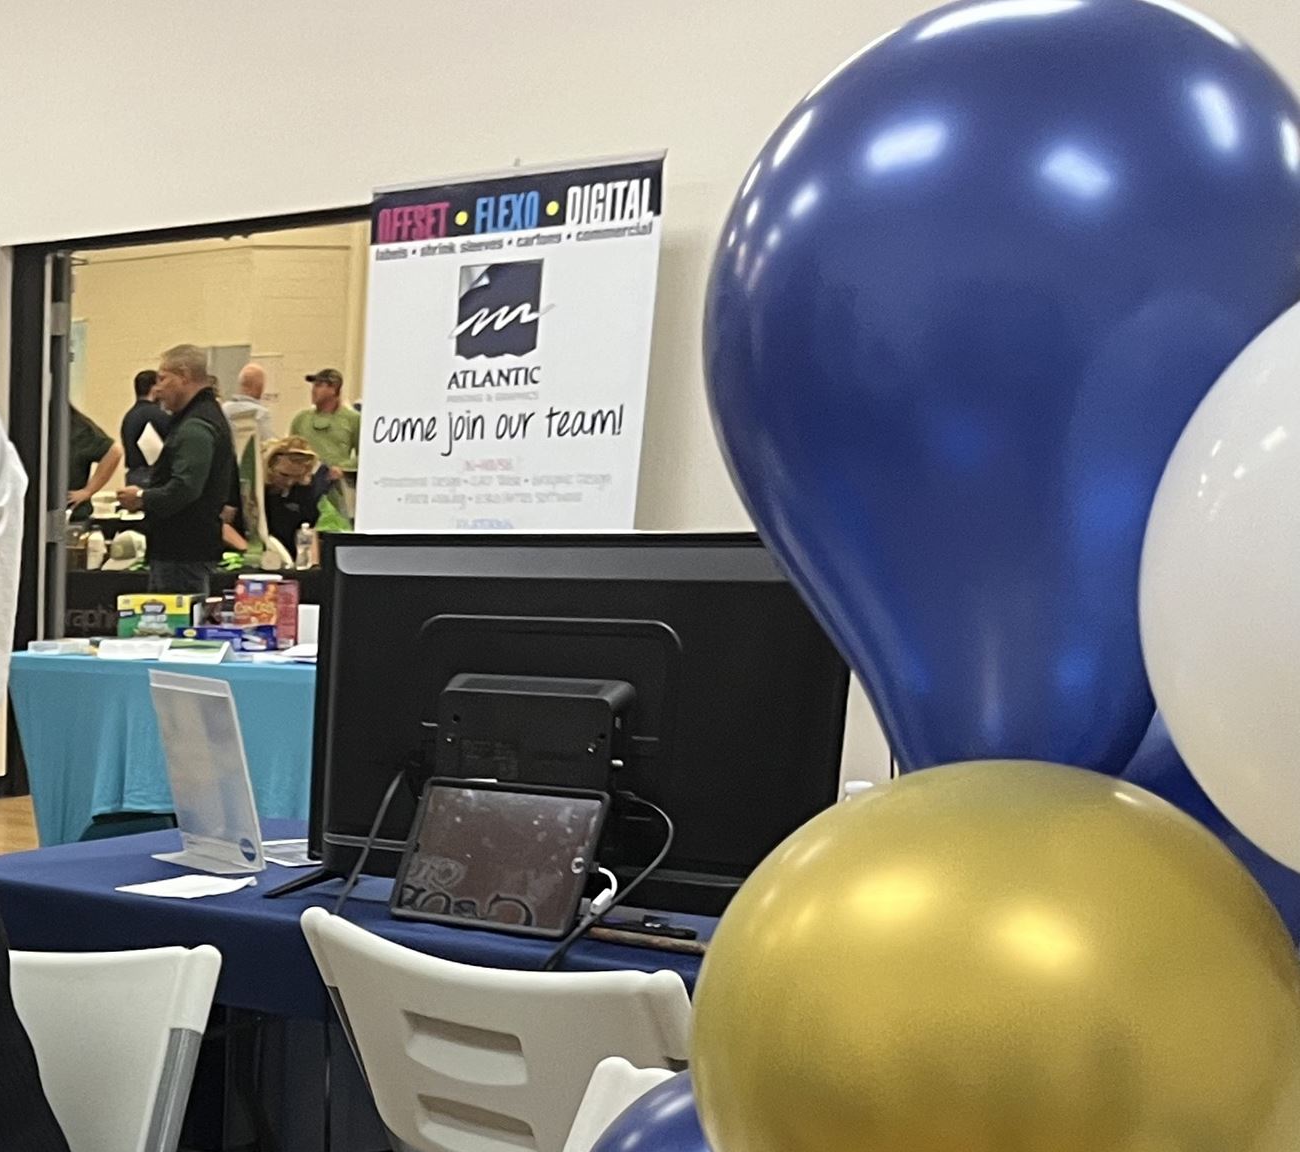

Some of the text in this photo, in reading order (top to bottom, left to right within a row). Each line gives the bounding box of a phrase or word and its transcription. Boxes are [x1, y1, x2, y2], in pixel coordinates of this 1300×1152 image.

[378, 177, 653, 243] OFFSET FLEXO DIGITAL
[446, 365, 541, 390] ATLANTIC
[372, 404, 624, 456] come join our team!
